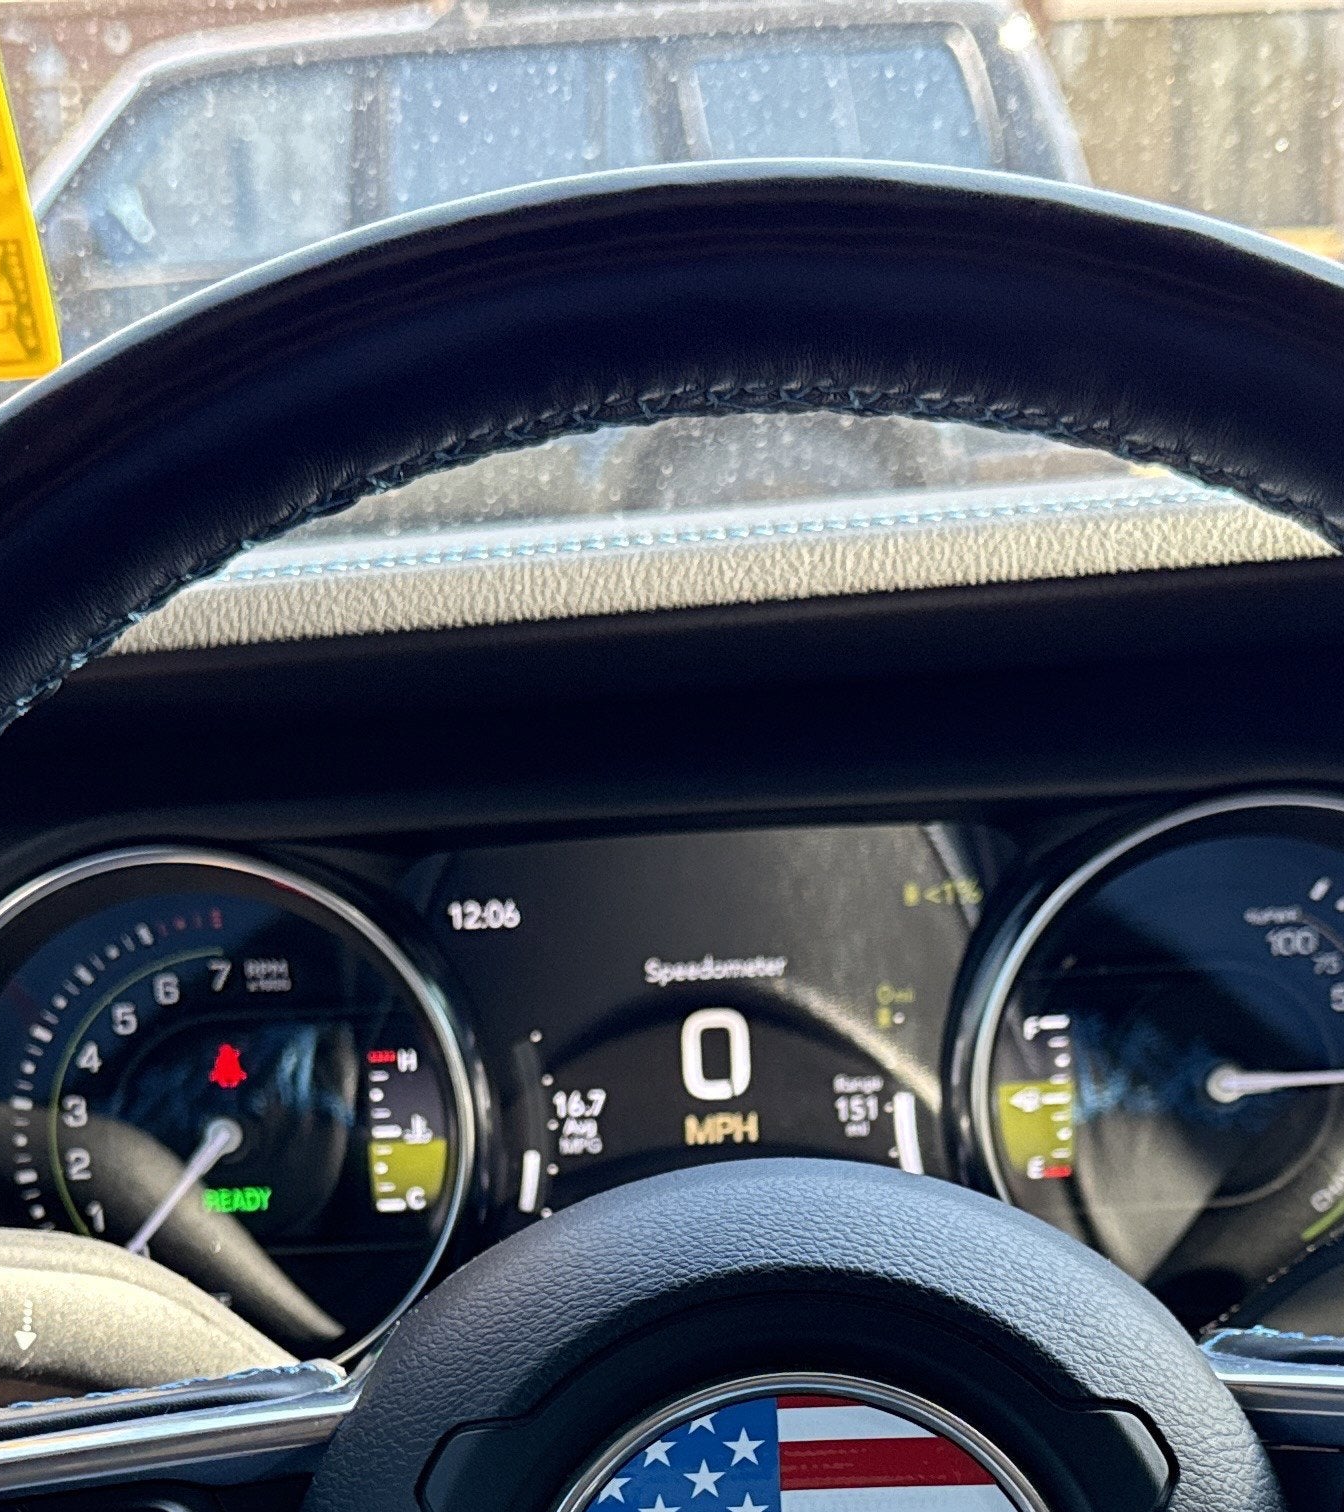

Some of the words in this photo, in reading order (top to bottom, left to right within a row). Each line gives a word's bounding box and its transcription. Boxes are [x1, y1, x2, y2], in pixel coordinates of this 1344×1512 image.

[447, 899, 520, 930] 12:06
[209, 961, 232, 992] 7
[644, 955, 788, 987] Speedometer
[154, 973, 180, 1005] 6
[112, 1002, 139, 1036] 5
[76, 1041, 102, 1073] 4
[397, 1049, 418, 1072] H
[680, 1007, 752, 1100] 0
[62, 1095, 87, 1127] 3
[552, 1088, 606, 1118] 16.7
[835, 1093, 879, 1122] 151
[684, 1112, 759, 1146] MPH
[67, 1148, 91, 1180] 2
[203, 1187, 272, 1213] READY
[405, 1187, 425, 1211] C
[87, 1201, 105, 1232] 1
